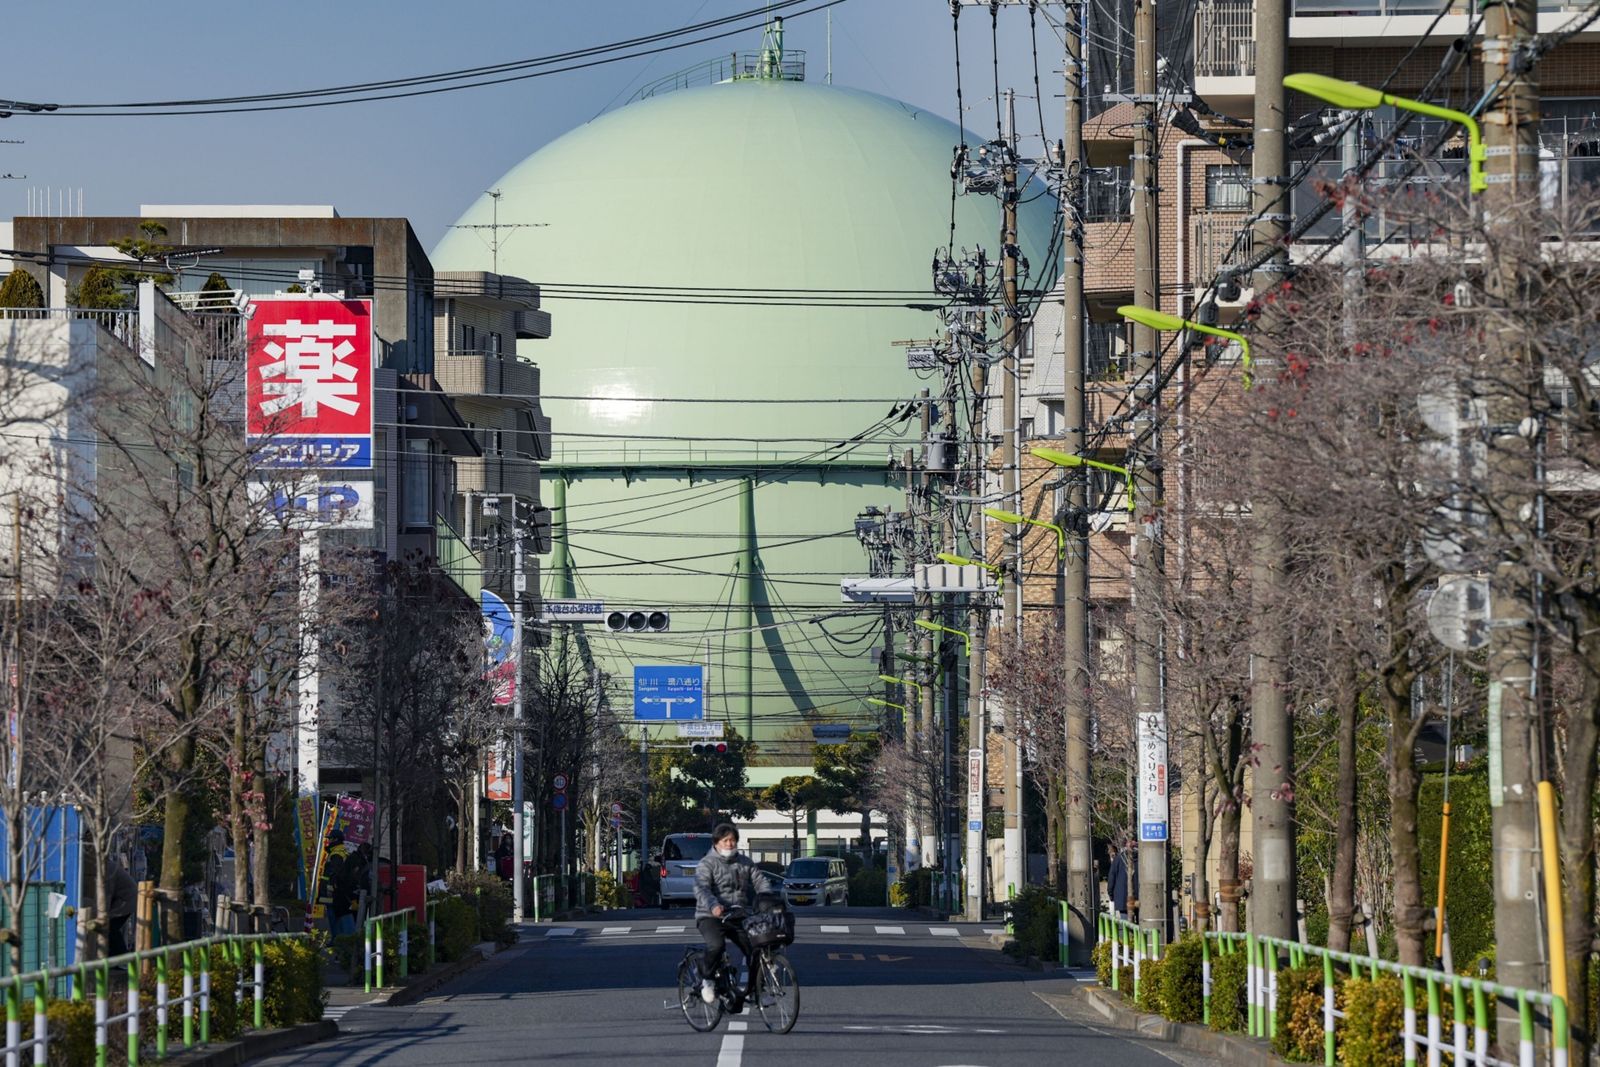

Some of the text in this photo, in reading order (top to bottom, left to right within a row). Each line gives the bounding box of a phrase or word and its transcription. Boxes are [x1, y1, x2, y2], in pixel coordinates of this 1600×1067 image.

[259, 319, 360, 419] 薬
[259, 444, 360, 462] ウエルシア
[318, 486, 360, 523] P
[667, 677, 700, 686] 環八通り
[1147, 741, 1157, 793] めぐりさわ
